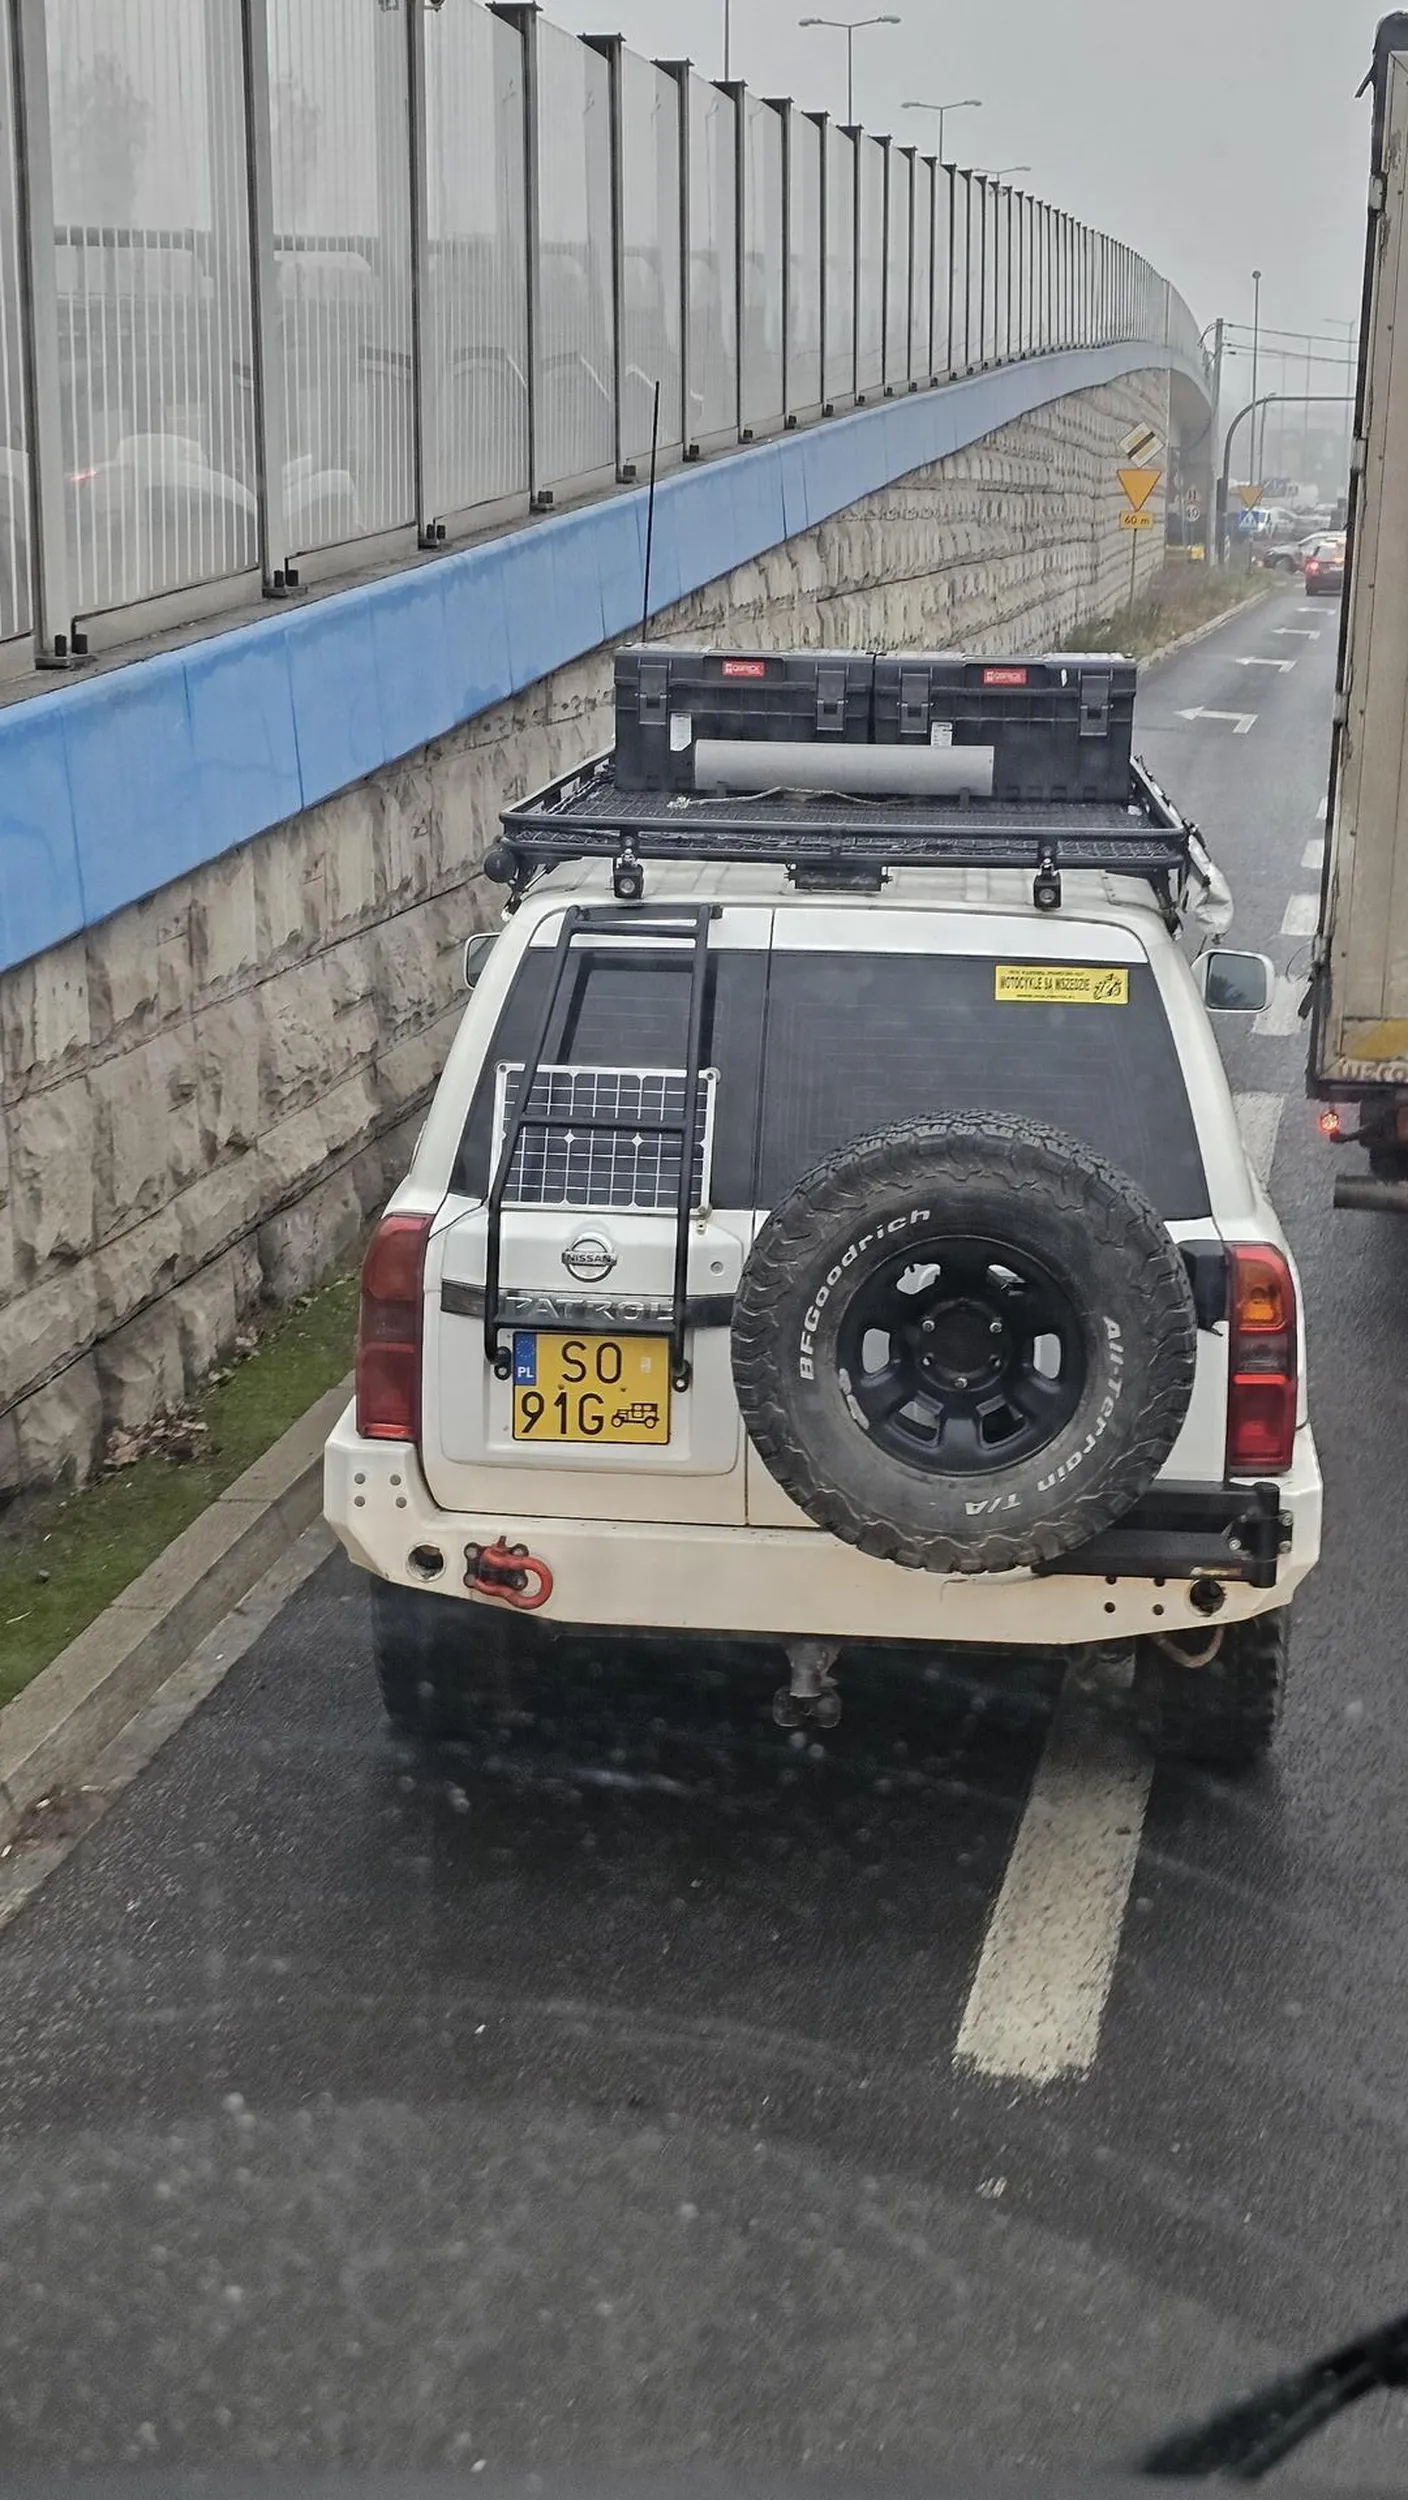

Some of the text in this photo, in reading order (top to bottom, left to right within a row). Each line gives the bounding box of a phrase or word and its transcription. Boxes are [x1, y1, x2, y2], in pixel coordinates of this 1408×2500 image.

[1124, 515, 1150, 525] 60 m
[1000, 976, 1043, 990] MOTOCYKLE
[567, 1253, 611, 1263] NISSAN
[800, 1209, 931, 1380] BFGoodrich
[506, 1296, 674, 1321] PATROL
[517, 1366, 535, 1379] PL
[561, 1340, 622, 1385] SO
[520, 1390, 604, 1436] 91G
[965, 1316, 1124, 1516] All-Terrain T/A
